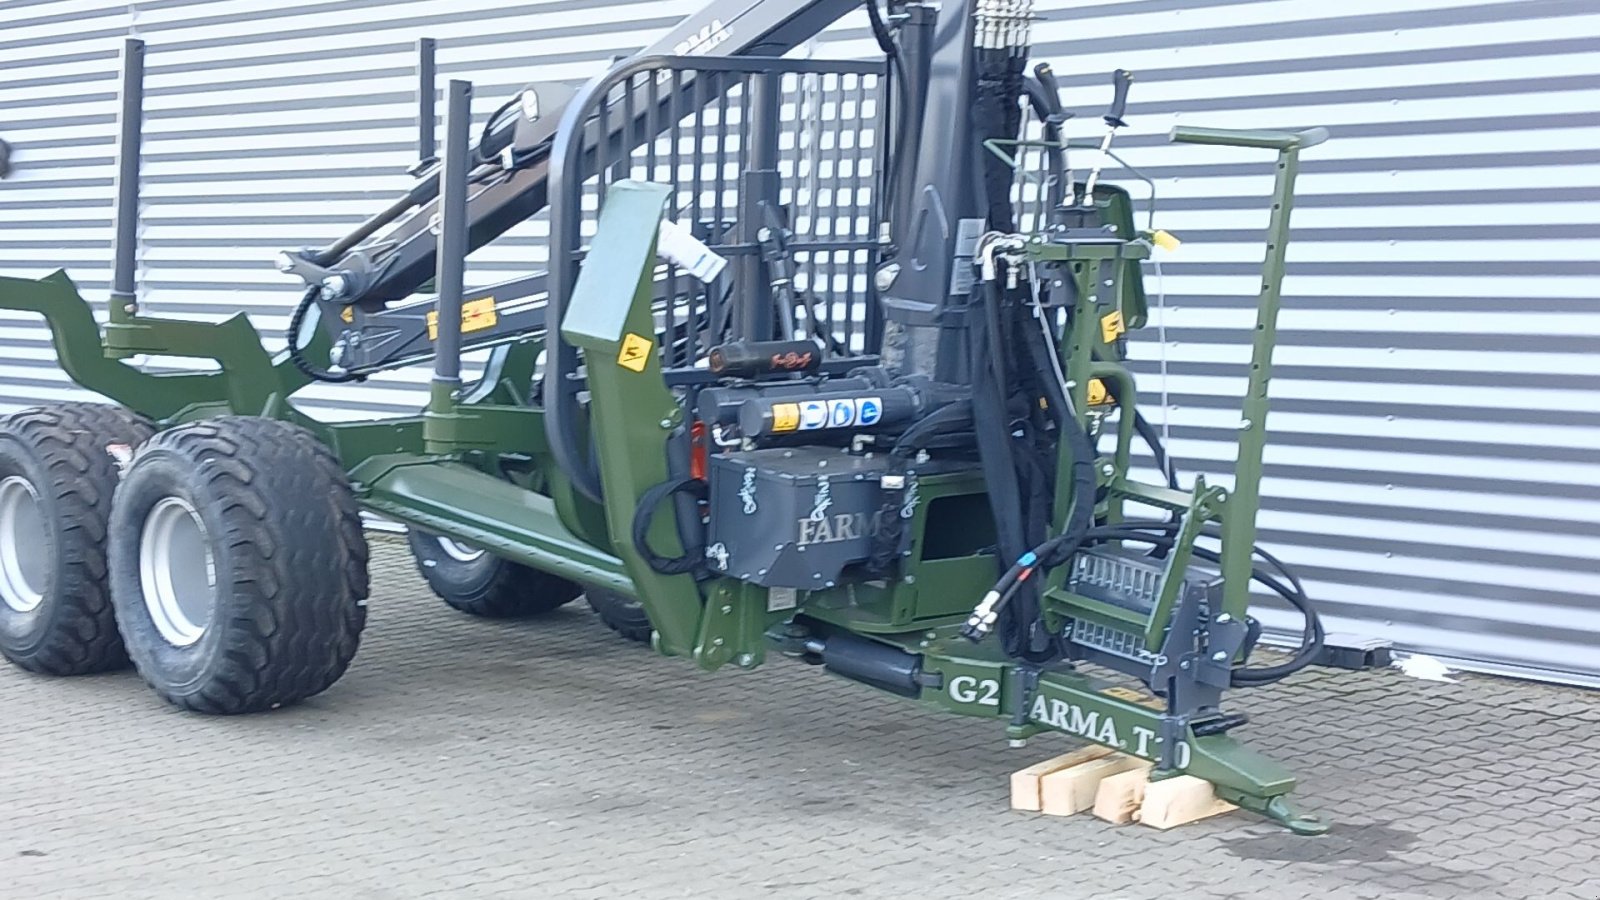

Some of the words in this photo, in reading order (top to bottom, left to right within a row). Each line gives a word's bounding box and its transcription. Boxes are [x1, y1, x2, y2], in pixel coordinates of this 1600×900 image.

[796, 511, 881, 545] FARM
[950, 676, 999, 706] G2
[1029, 694, 1121, 748] ARMA
